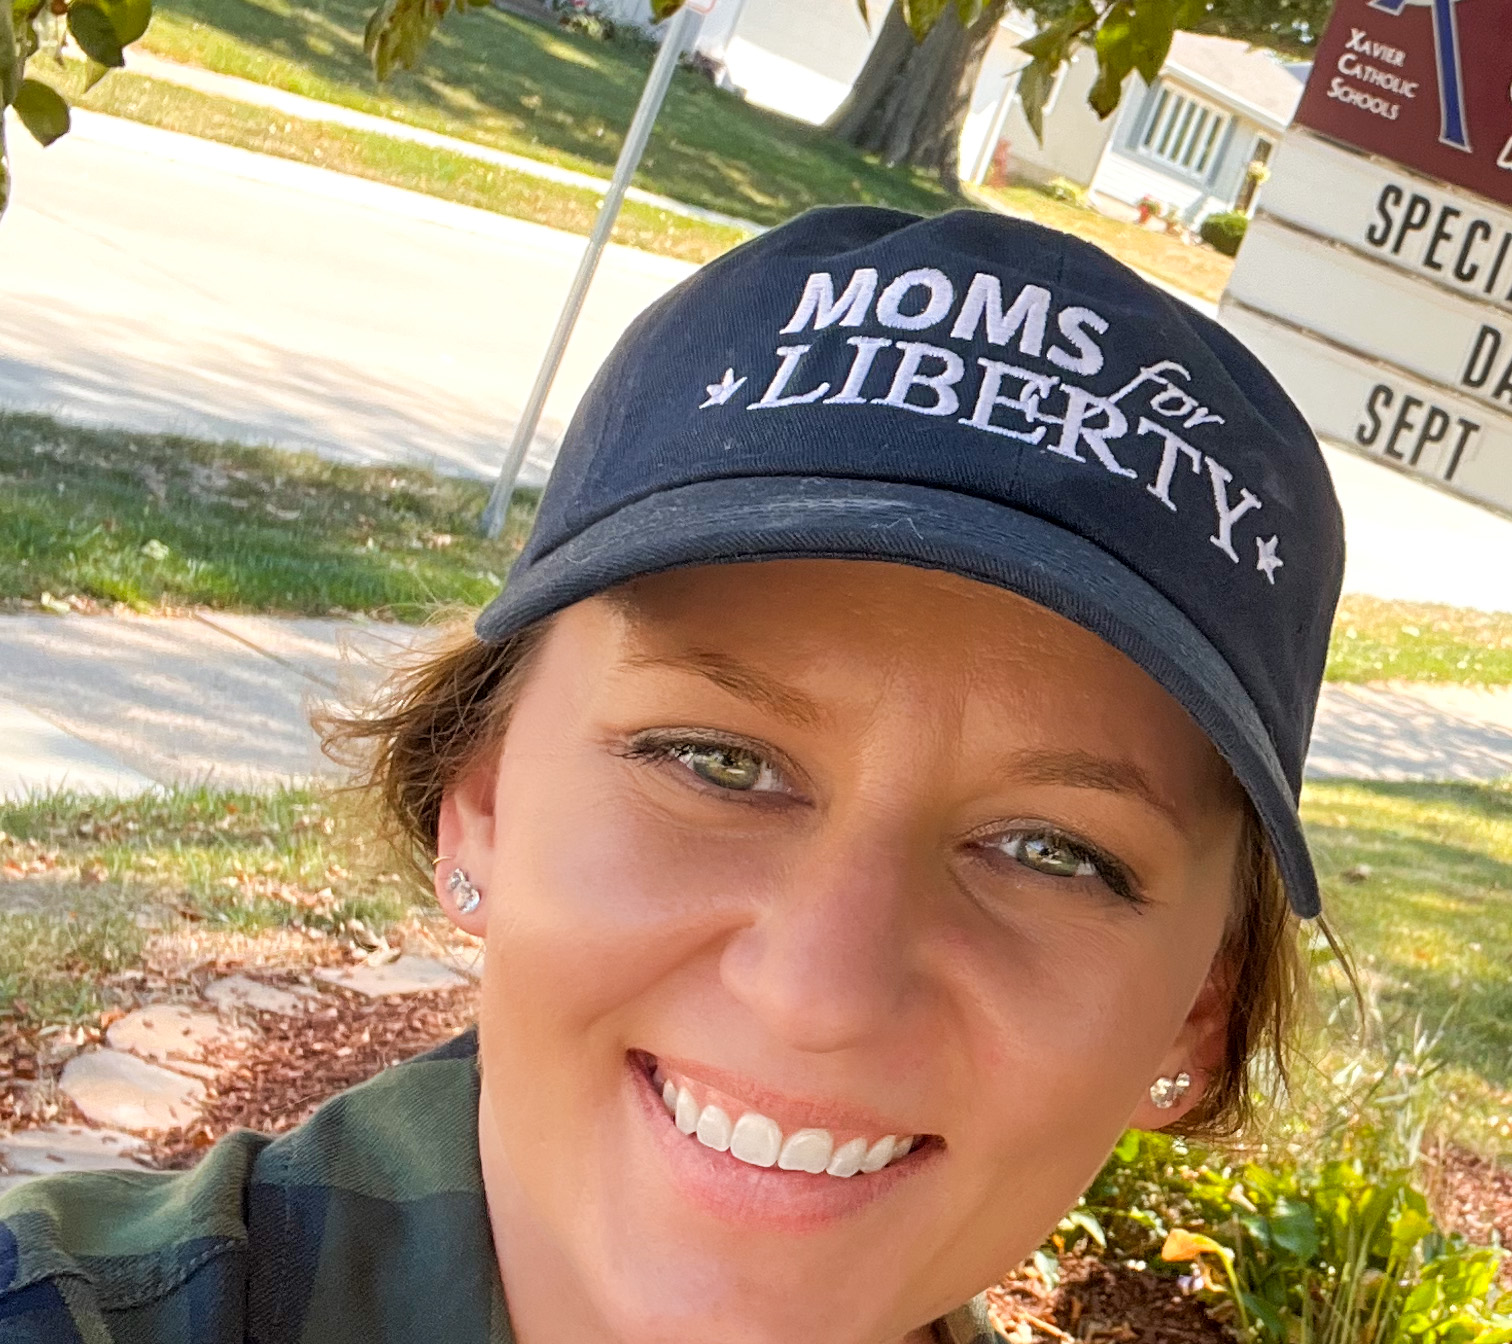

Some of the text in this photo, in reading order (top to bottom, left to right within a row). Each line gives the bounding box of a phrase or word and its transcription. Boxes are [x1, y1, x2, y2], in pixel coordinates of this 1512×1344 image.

[780, 267, 1224, 429] MOMS for
[746, 336, 1262, 564] LIBERTY
[1356, 384, 1481, 482] SEPT
